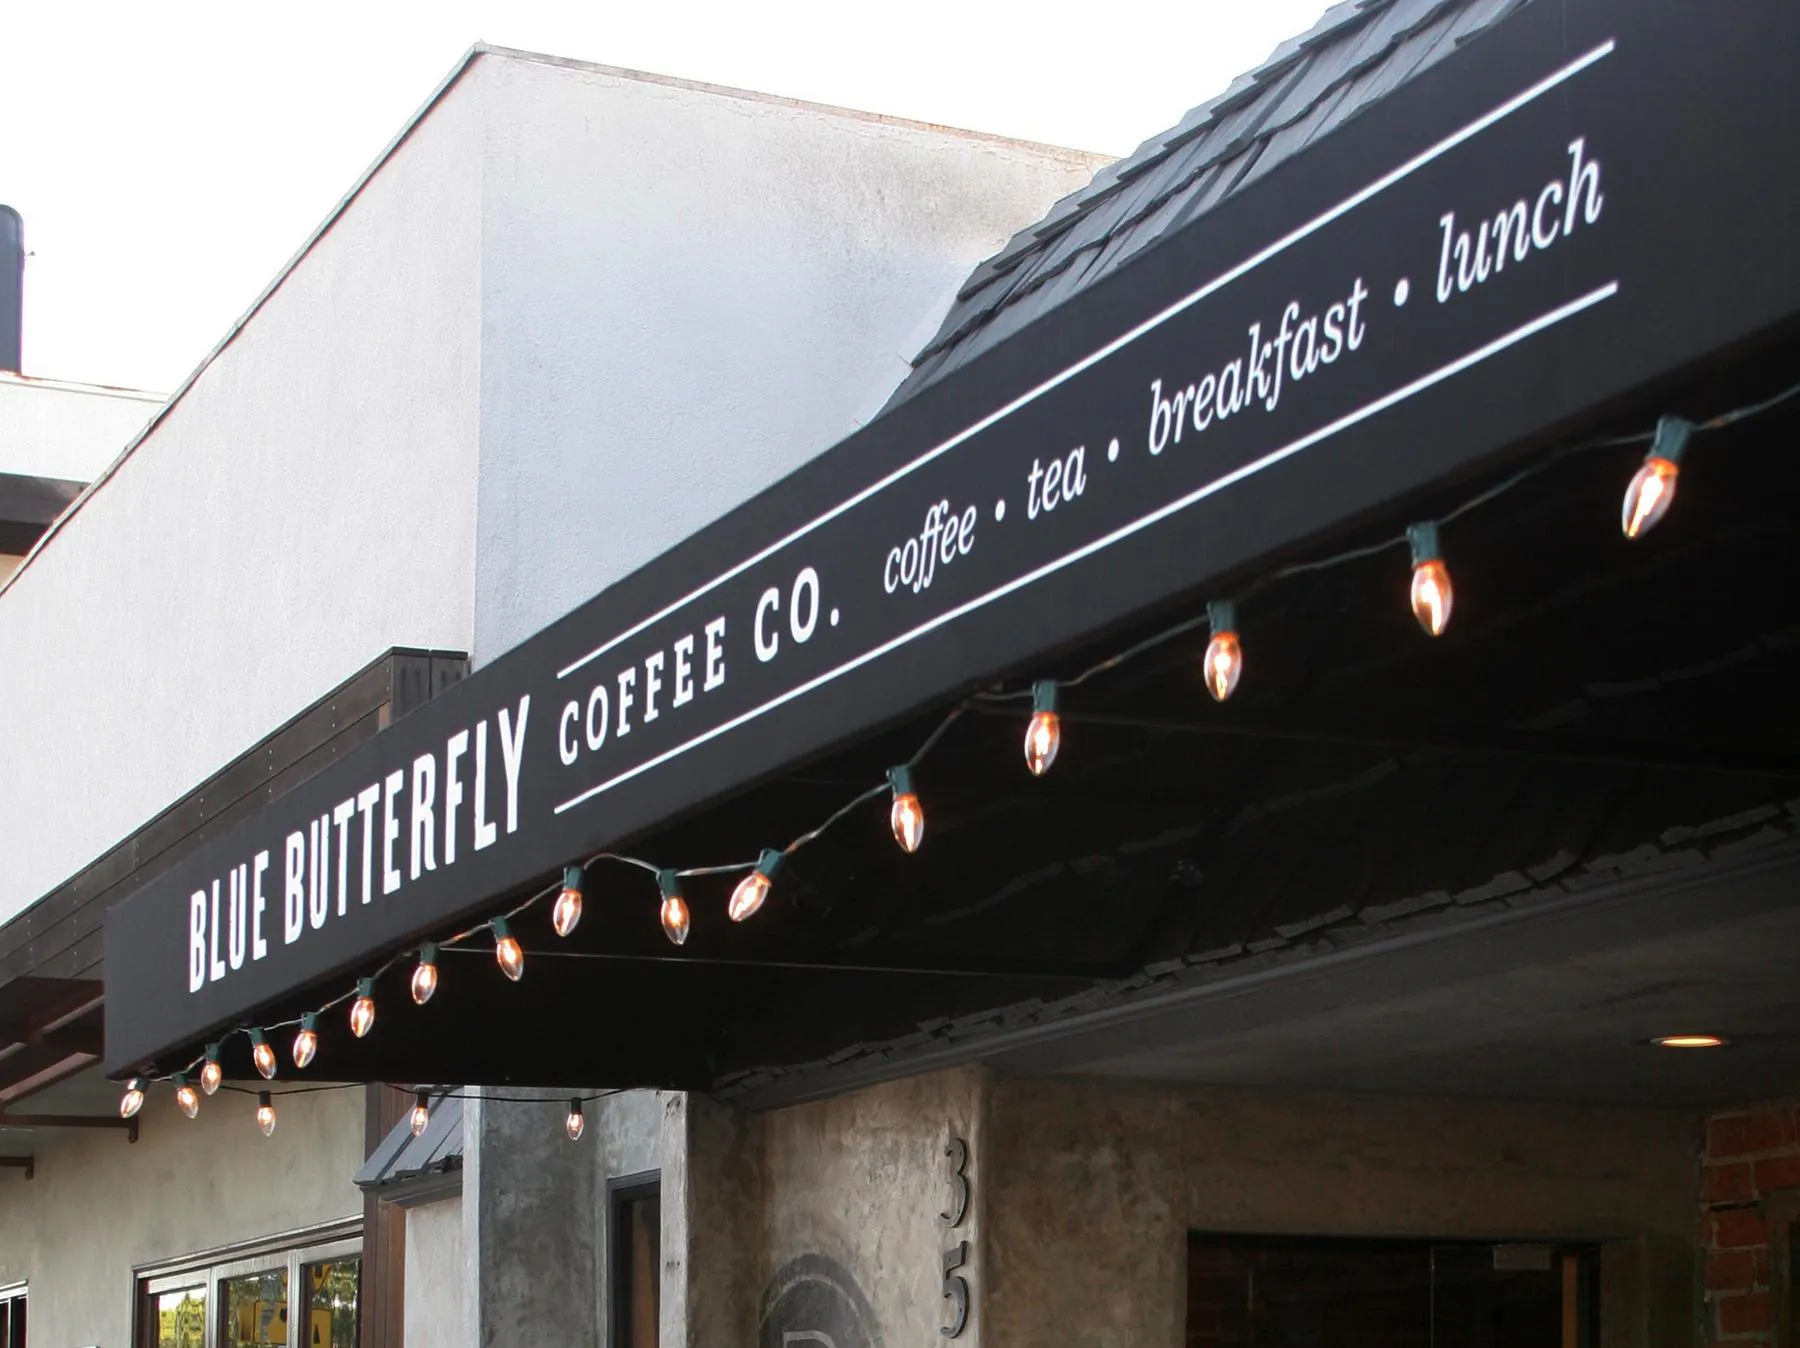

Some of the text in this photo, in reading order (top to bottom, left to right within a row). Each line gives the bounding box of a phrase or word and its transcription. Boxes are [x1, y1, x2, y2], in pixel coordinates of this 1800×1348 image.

[882, 136, 1605, 595] coffee tea breakfast lunch
[557, 565, 841, 767] COFFEE CO.
[188, 692, 532, 995] BLUE BUTTERFLY
